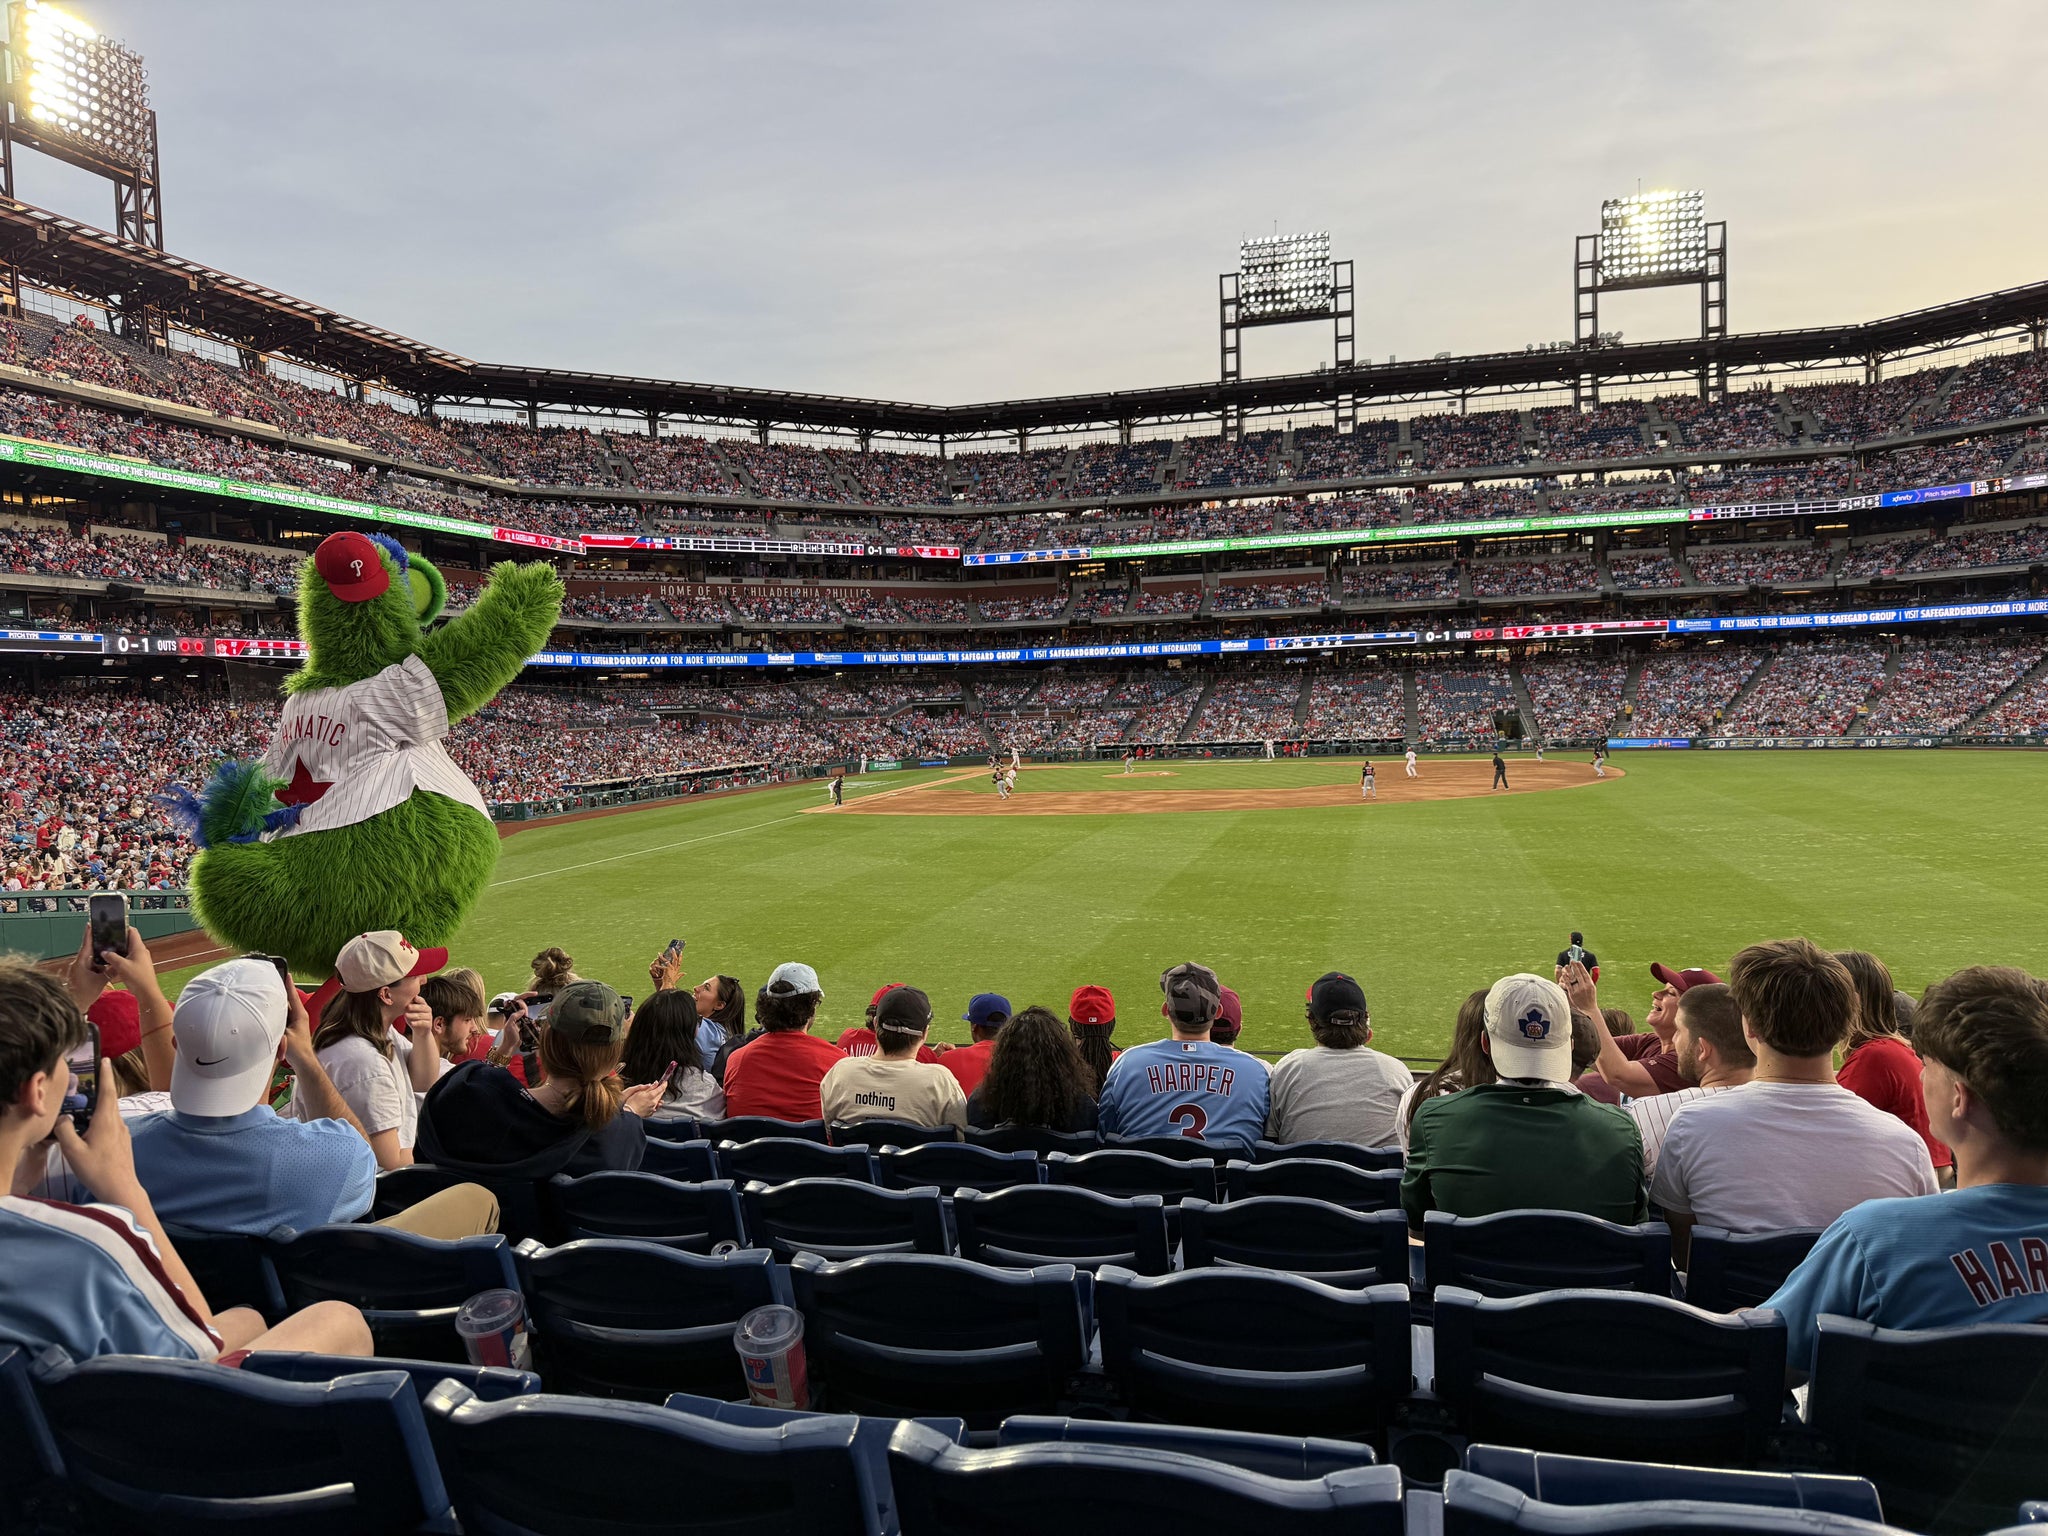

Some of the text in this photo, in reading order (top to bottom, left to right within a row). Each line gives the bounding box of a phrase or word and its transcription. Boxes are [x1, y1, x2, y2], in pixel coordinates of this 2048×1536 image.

[56, 454, 89, 468] OFFICIAL
[89, 461, 121, 473] PARTNER
[121, 464, 131, 474] OF
[131, 465, 144, 477] THE
[144, 467, 173, 481] PHILLIES
[173, 474, 203, 487] GROUNDS
[203, 479, 220, 489] CREW
[250, 487, 274, 500] OFFICIAL
[1892, 488, 1961, 503] xfinity Pitch Speed
[1551, 518, 1575, 526] OFFICIAL
[1576, 516, 1600, 525] PARTNER
[1600, 515, 1608, 523] OF
[1608, 515, 1619, 523] THE
[1619, 514, 1643, 522] PHILLIES
[1643, 513, 1669, 521] GROUNDS
[1419, 527, 1442, 535] PARTNER
[1508, 521, 1525, 529] CREW
[793, 544, 800, 552] R
[811, 544, 818, 552] H
[867, 546, 882, 556] 0-1
[1111, 547, 1131, 555] OFFICIAL
[1131, 545, 1152, 553] PARTNER
[1168, 543, 1188, 551] PHILLIES
[350, 559, 364, 578] P
[660, 585, 692, 596] HOME
[698, 585, 711, 596] OF
[1719, 602, 2048, 629] PHLY THANKS THEIR TEAMMATE: THE SAFEGARD GROUP VISIT SAFEGARDGROUP.COM FOR MORE
[1425, 630, 1472, 642] 0-1 OUTS
[118, 636, 177, 653] 0-1 OUTS
[248, 648, 260, 656] .269
[863, 643, 1201, 662] PHLY THANKS THEIR TEAMMATE: THE SAFEGARD GROUP VISIT SAFEGARDGROUP.COM FOR MORE INFORMATION
[555, 654, 573, 664] GROUP
[581, 655, 592, 665] VISIT
[592, 655, 668, 665] SAFEGARDGROUP.COM
[670, 656, 684, 665] FOR
[686, 656, 704, 665] MORE
[706, 655, 748, 664] INFORMATION
[1715, 739, 1726, 748] 10
[1763, 739, 1774, 748] 10
[1814, 739, 1825, 748] 10
[1865, 738, 1877, 748] 10
[1920, 738, 1932, 747] 10
[1146, 1062, 1236, 1098] HARPER
[855, 1091, 895, 1111] nothing
[1168, 1103, 1208, 1141] 3
[1949, 1237, 2048, 1308] HAR
[746, 1357, 767, 1380] P
